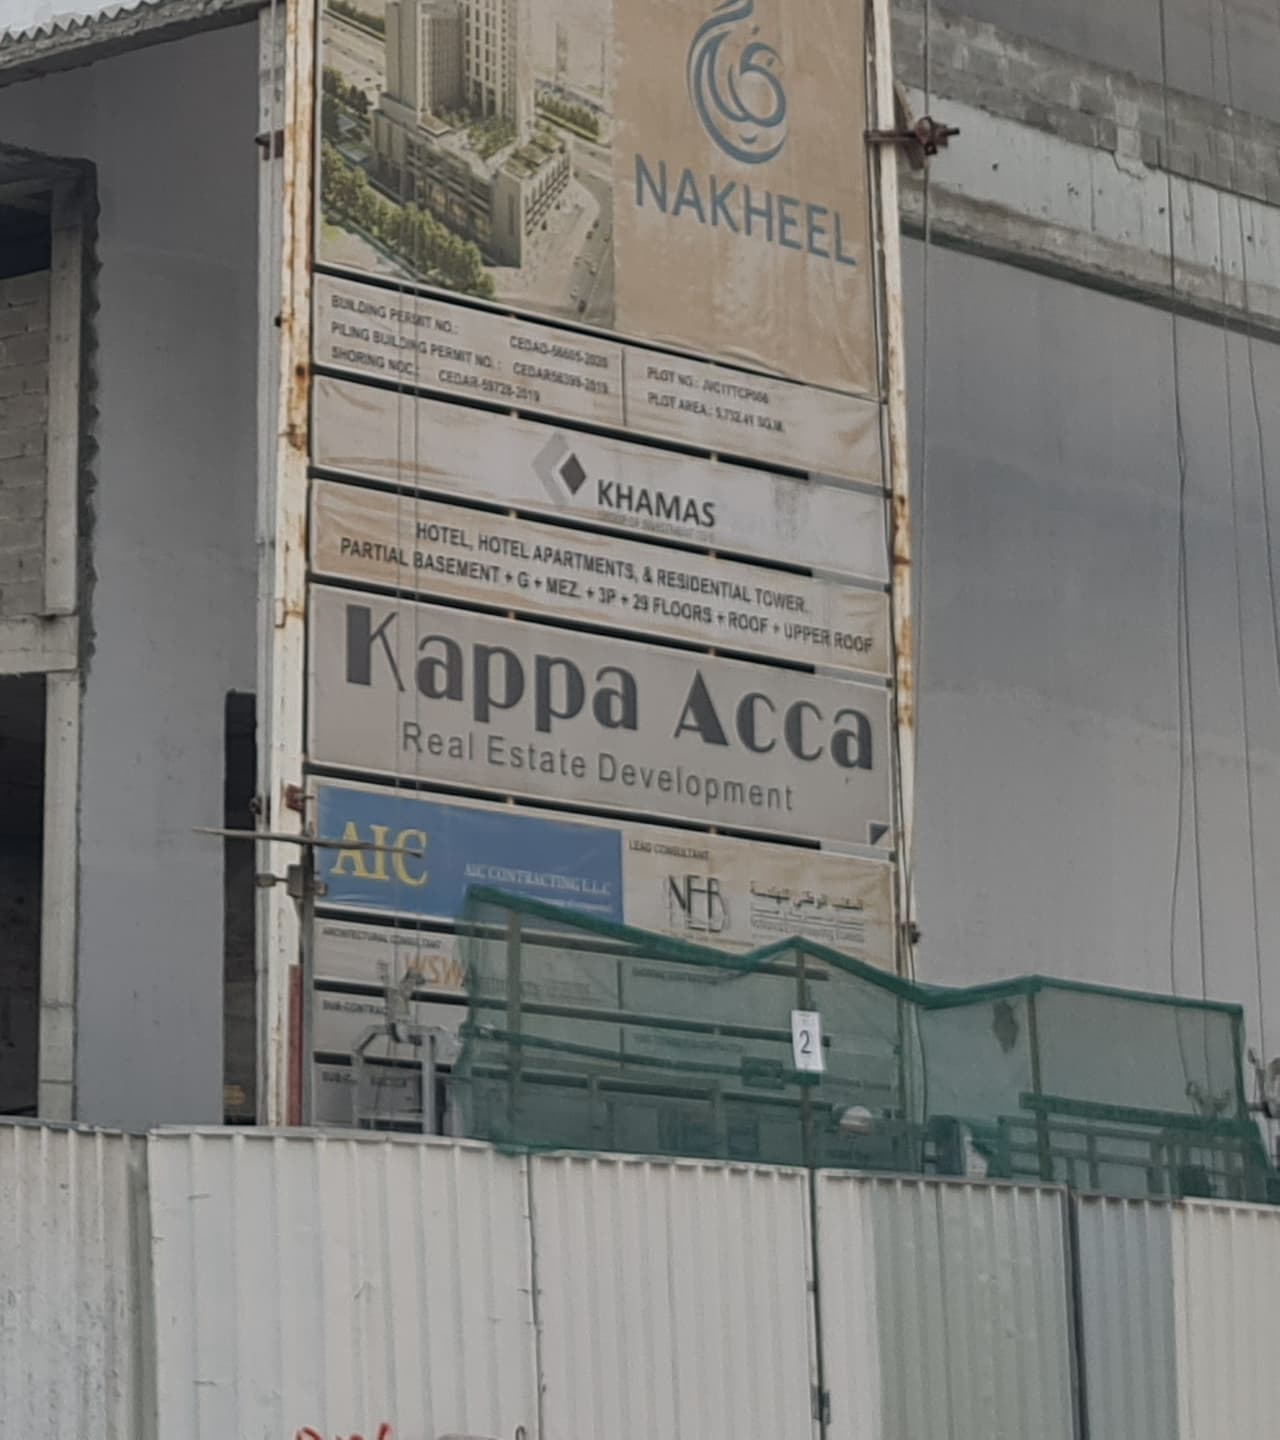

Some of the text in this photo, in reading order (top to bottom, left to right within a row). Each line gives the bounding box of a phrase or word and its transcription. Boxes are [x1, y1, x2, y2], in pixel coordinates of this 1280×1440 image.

[635, 154, 857, 267] NAKHEEL
[331, 294, 387, 320] BUILDING
[390, 308, 433, 330] PERMIT
[331, 321, 370, 342] PILING
[373, 330, 428, 355] BUILDING
[430, 343, 473, 364] PERMIT
[331, 345, 386, 370] SHORING
[647, 366, 675, 383] PLOT
[647, 392, 676, 409] PLOT
[597, 479, 716, 528] KHAMAS
[416, 522, 473, 550] HOTEL,
[478, 534, 528, 559] HOTEL
[533, 545, 639, 583] APARTMENTS,
[642, 566, 653, 584] &
[657, 568, 750, 603] RESIDENTIAL
[341, 537, 408, 566] PARTIAL
[413, 551, 500, 583] BASEMENT
[517, 571, 530, 588] G
[598, 586, 616, 604] 3P
[653, 596, 712, 624] FLOORS
[727, 611, 768, 633] ROOF
[784, 623, 831, 645] UPPER
[834, 631, 874, 653] ROOF
[345, 604, 873, 770] Kappa Acca
[402, 721, 793, 811] Real Estate Development
[329, 819, 428, 887] AIC
[629, 839, 710, 861] LEAD CONSULTANT
[488, 865, 581, 892] CONTRACTING
[800, 1030, 811, 1054] 2
